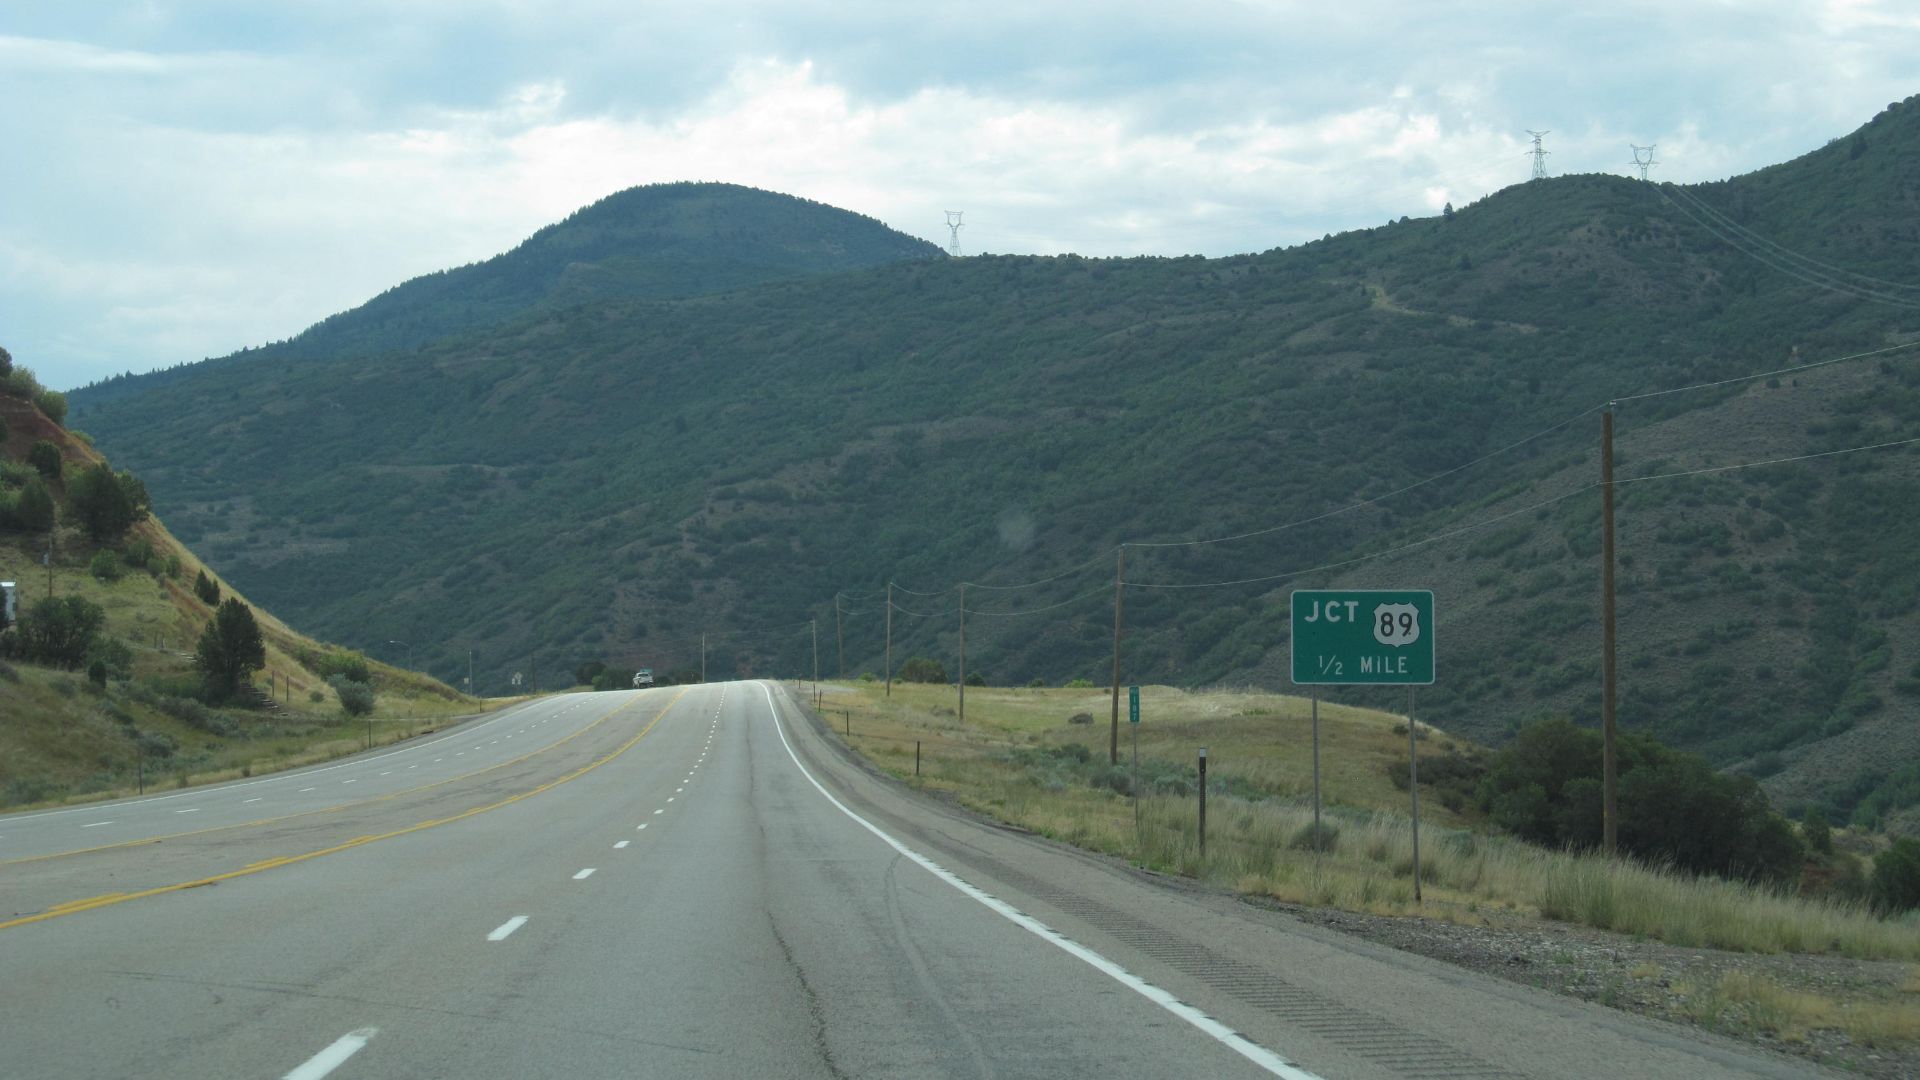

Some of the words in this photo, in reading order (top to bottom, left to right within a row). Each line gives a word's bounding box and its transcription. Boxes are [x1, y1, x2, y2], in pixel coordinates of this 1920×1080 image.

[1304, 600, 1359, 622] JCT
[1380, 612, 1413, 637] 89
[1318, 655, 1343, 675] 1/2
[1360, 656, 1408, 674] MILE
